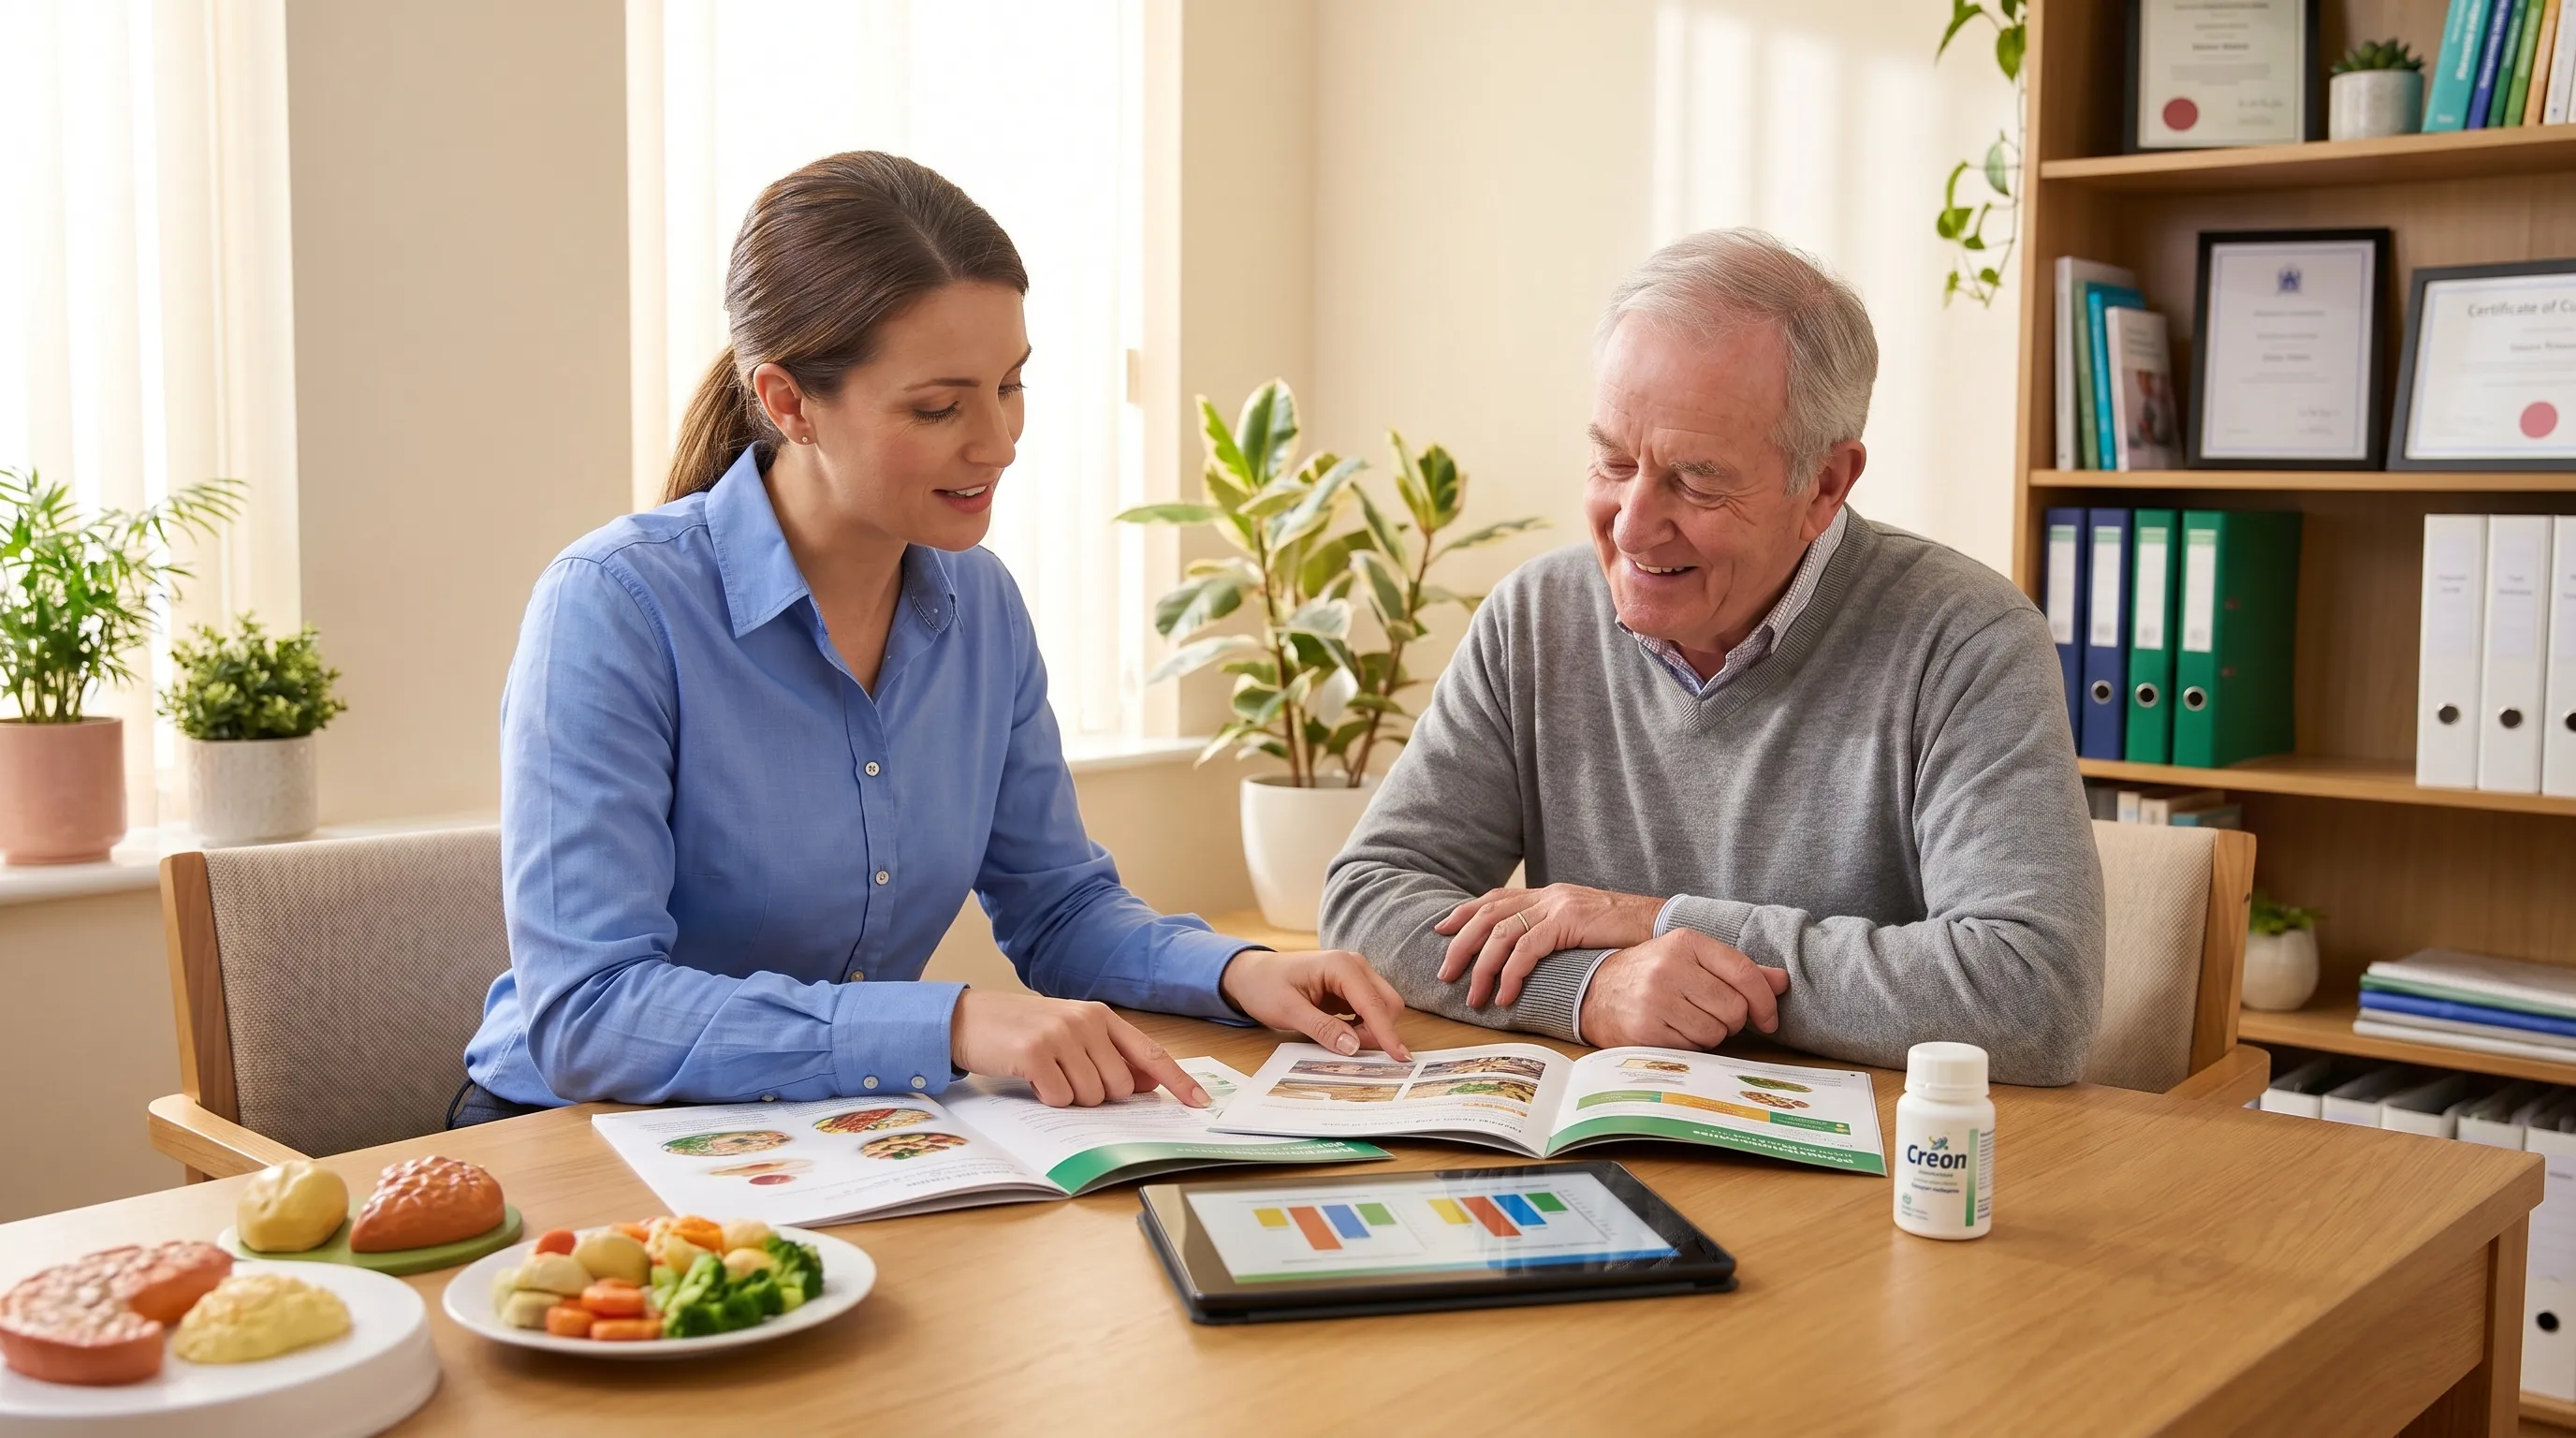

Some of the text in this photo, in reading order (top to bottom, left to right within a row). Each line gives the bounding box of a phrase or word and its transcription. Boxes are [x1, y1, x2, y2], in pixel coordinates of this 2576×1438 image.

[2466, 301, 2538, 318] Certificate
[2540, 298, 2557, 315] of
[1907, 1144, 1968, 1170] Creon
